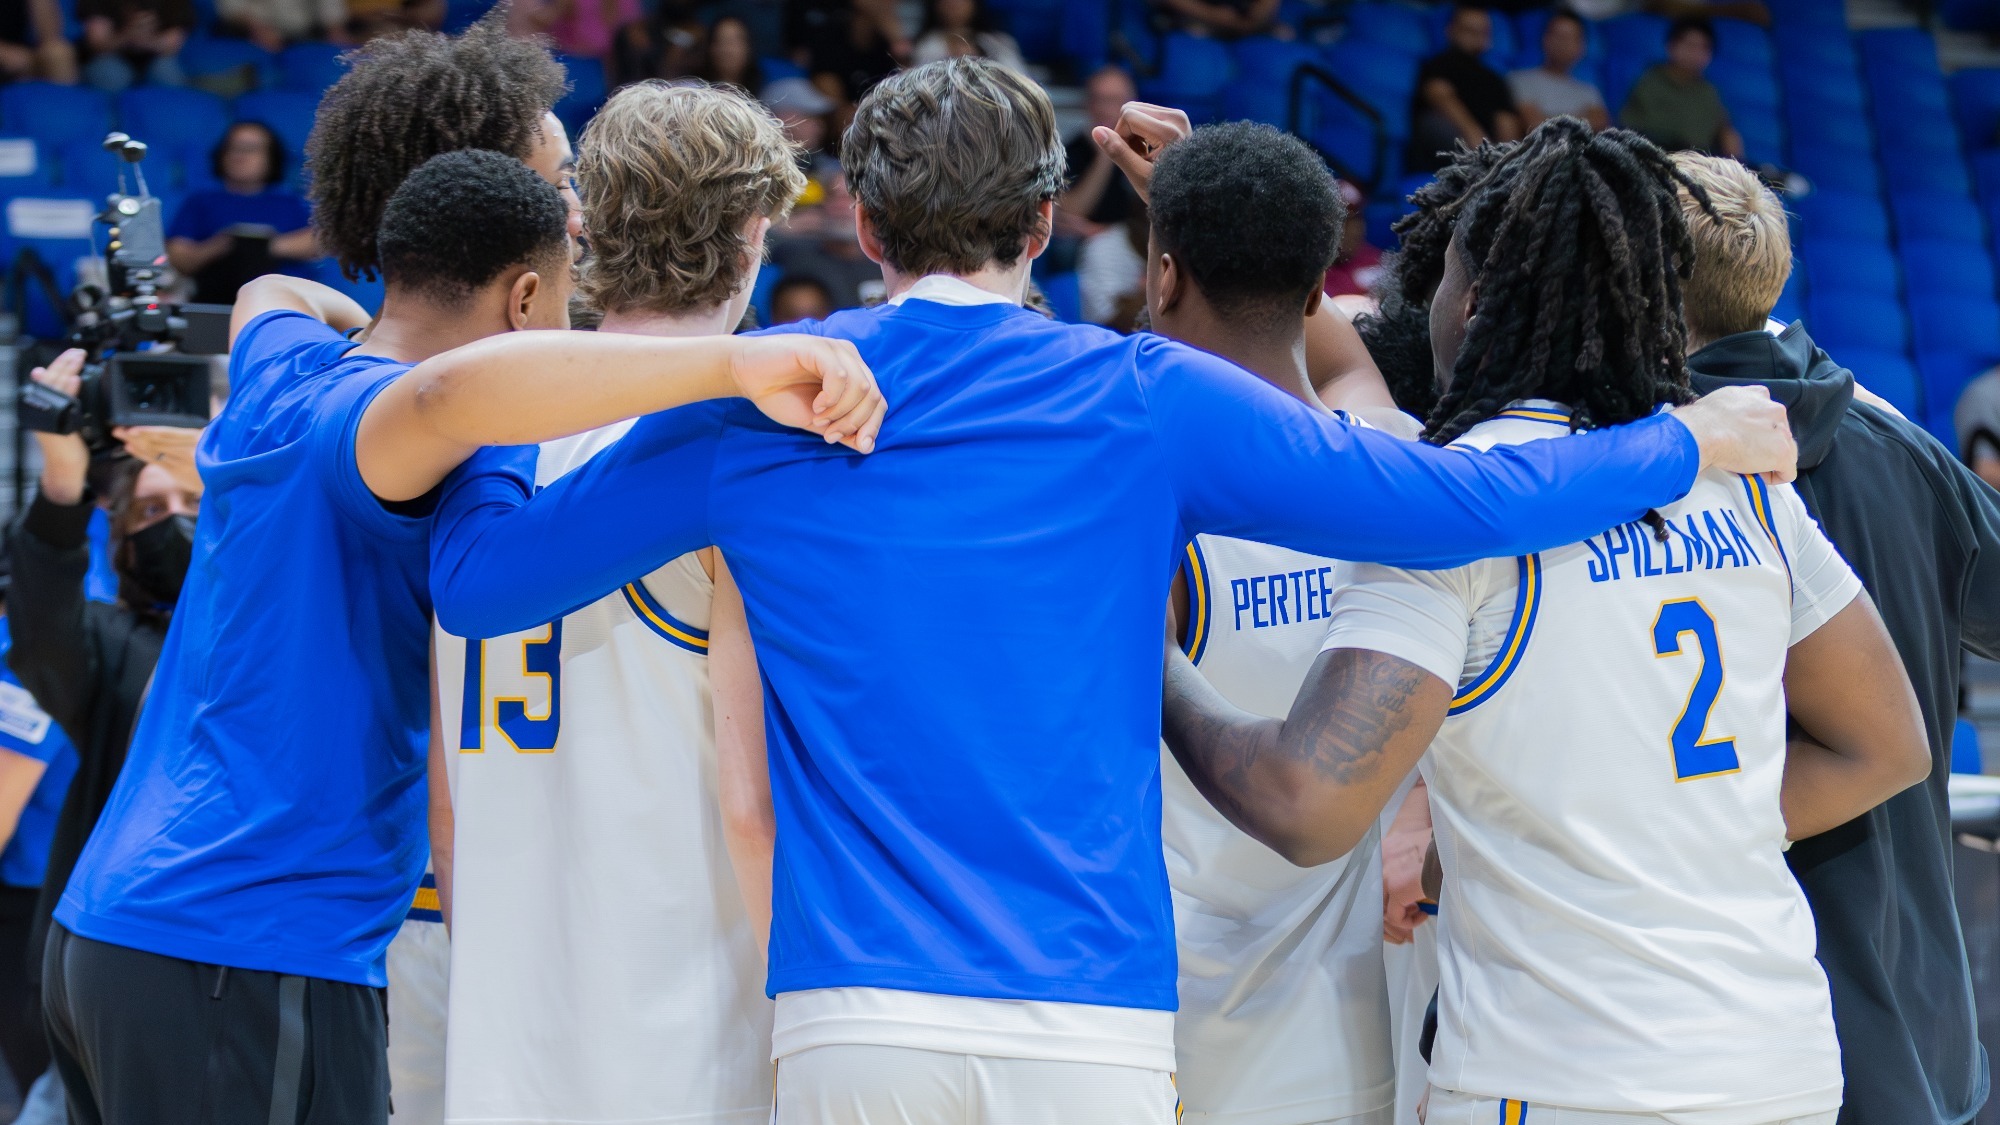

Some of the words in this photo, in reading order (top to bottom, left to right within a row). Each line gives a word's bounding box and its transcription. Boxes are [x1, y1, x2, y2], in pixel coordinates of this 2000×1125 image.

[1230, 566, 1335, 631] PERTEE
[1584, 508, 1762, 583] SPILLMAN
[459, 617, 564, 754] 13
[1649, 595, 1742, 784] 2
